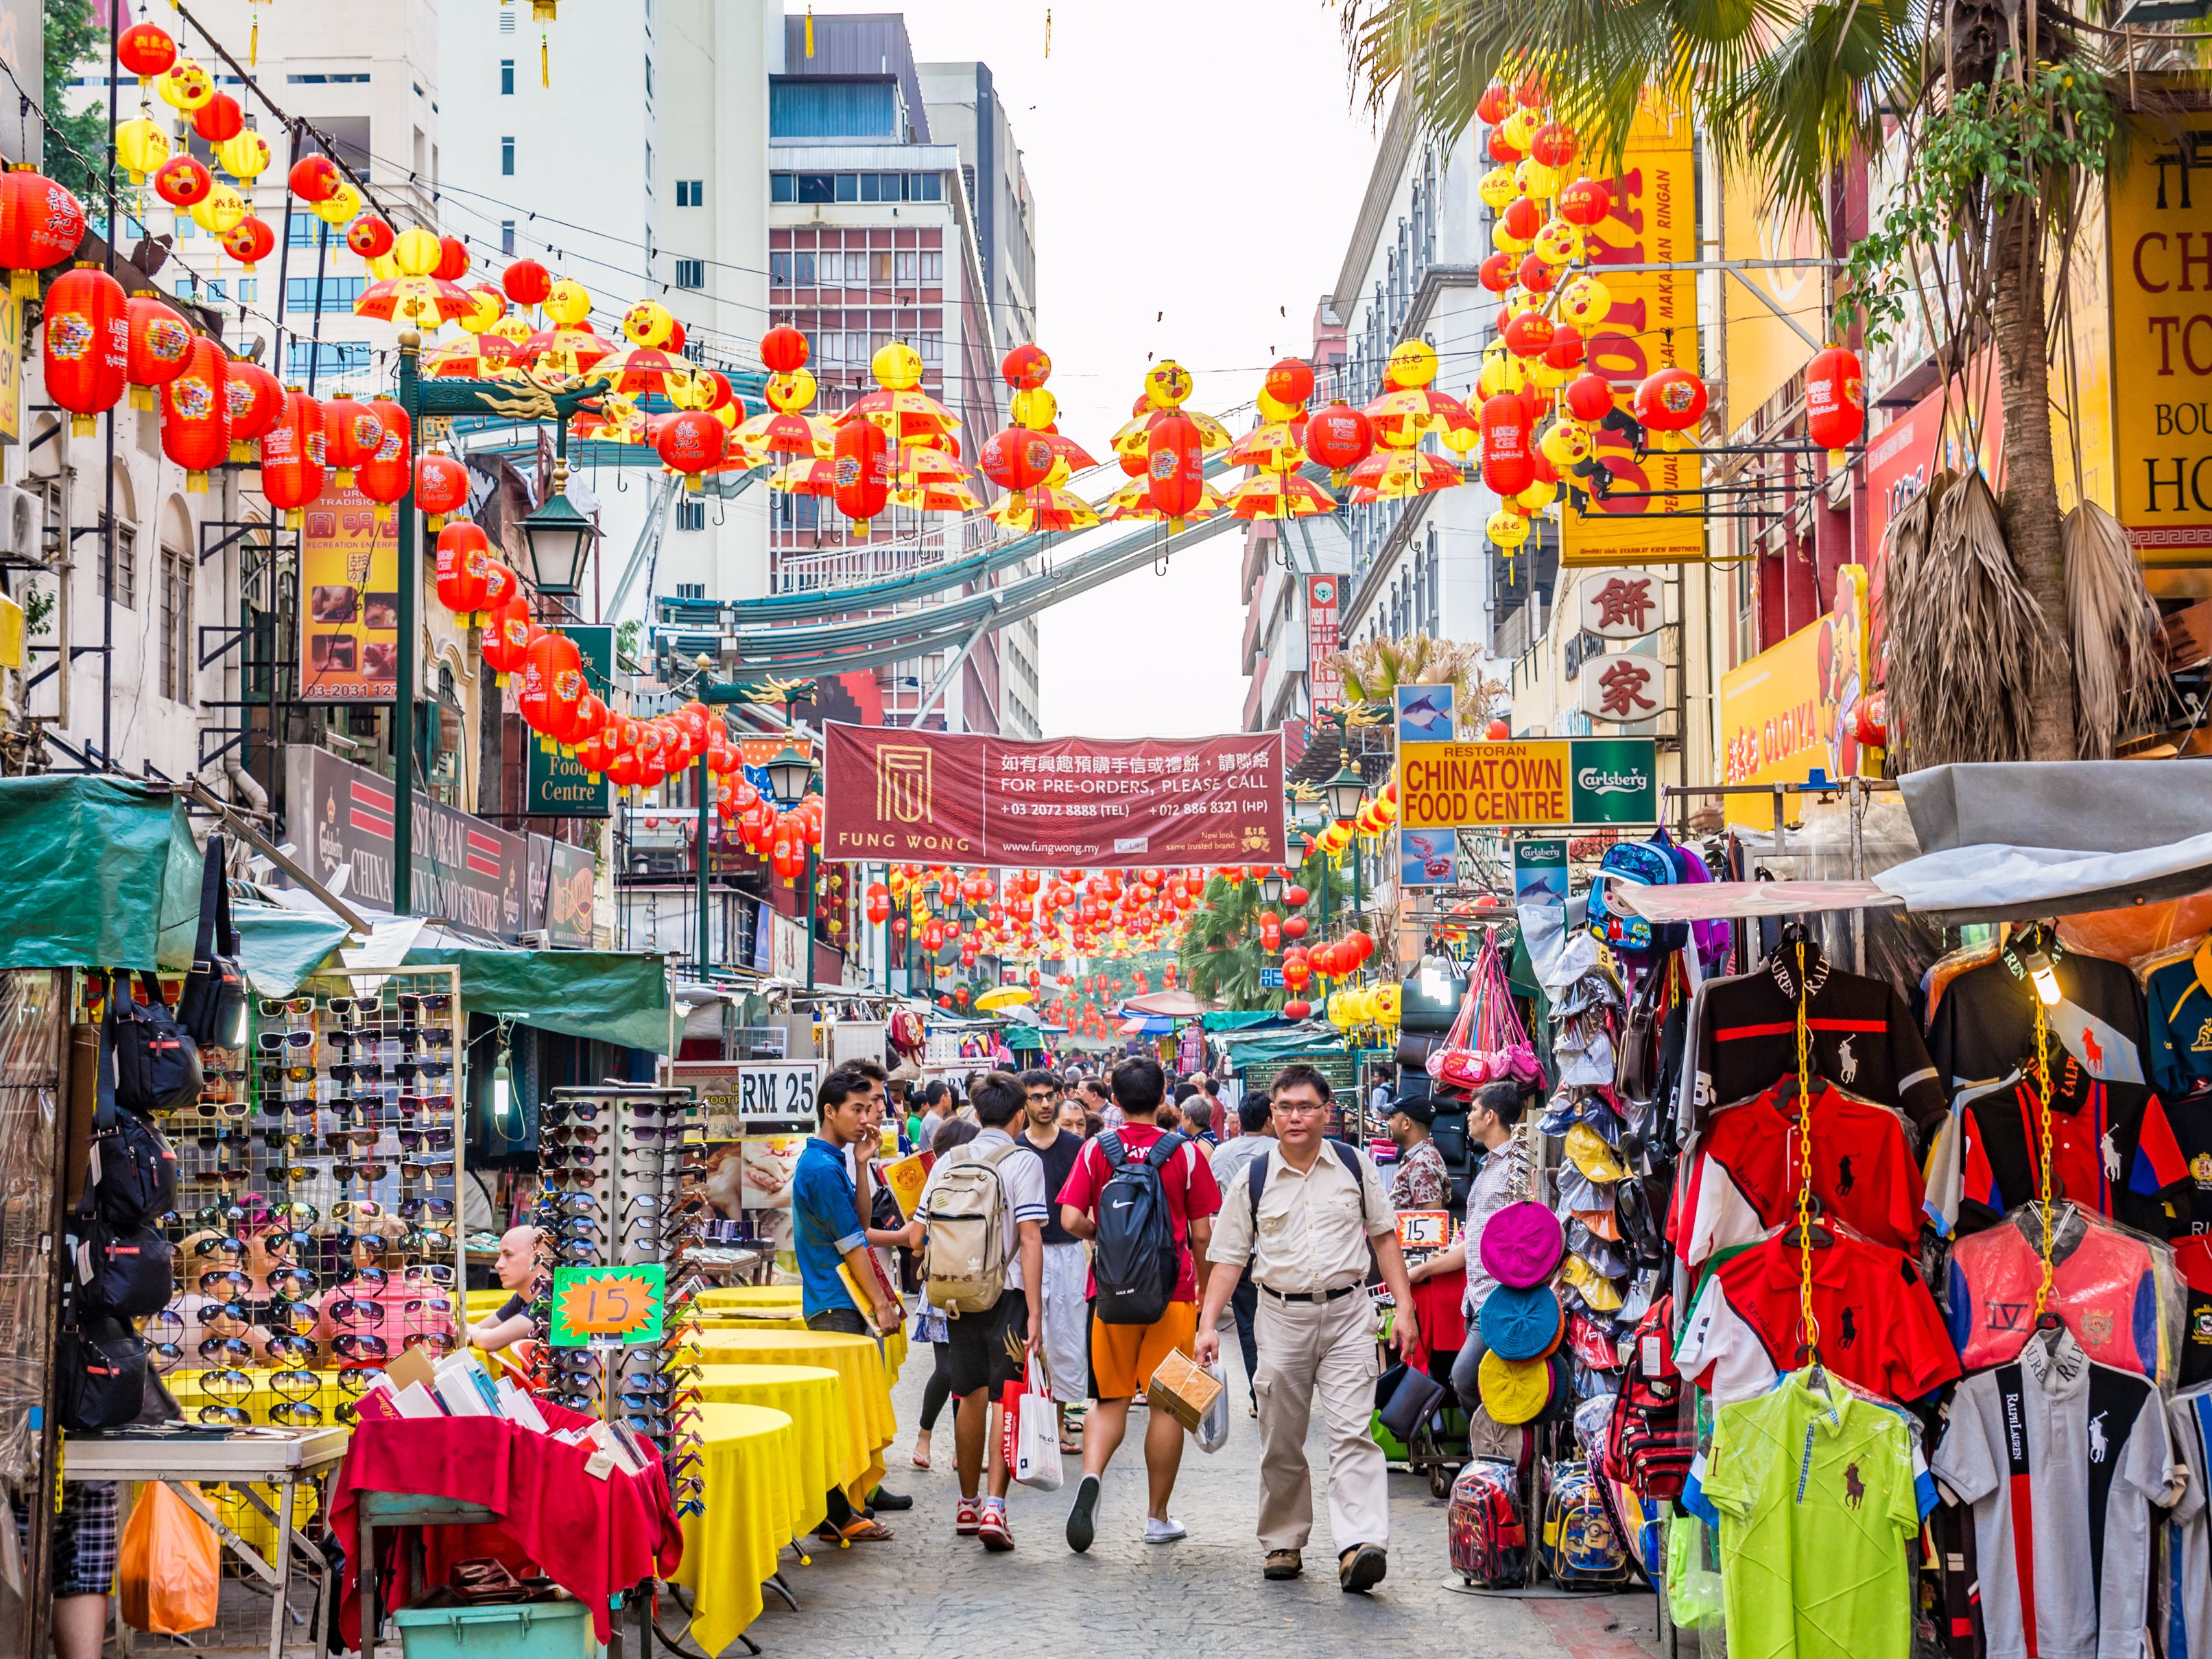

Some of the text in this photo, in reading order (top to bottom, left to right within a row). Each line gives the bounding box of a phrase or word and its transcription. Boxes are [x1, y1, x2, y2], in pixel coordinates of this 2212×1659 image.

[1656, 169, 1671, 230] RINGAN
[308, 684, 368, 697] 03-2031
[1597, 659, 1656, 716] 家
[1763, 698, 1819, 766] OLOIYA
[1443, 745, 1526, 757] RESTORAN
[1001, 774, 1268, 796] FOR PRE-ORDERS, PLEASE CALL
[1405, 758, 1562, 791] CHINATOWN
[1578, 767, 1648, 791] Carlsberg
[541, 780, 595, 801] Centre
[1001, 800, 1268, 818] +03 2072 8888 (TEL) +012 886 8321 (HP)
[1405, 791, 1565, 822] FOOD CENTRE
[839, 833, 969, 851] FUNG WONG
[1187, 842, 1213, 850] trusted
[1215, 842, 1235, 850] brand
[1201, 831, 1217, 840] New
[1002, 842, 1145, 856] www.fungwong.my Like
[1521, 846, 1560, 861] Carlsberg
[430, 873, 459, 920] FOOD
[460, 883, 499, 934] CENTRE
[704, 1095, 734, 1105] FOOT
[741, 1071, 814, 1114] RM 25
[1405, 1219, 1430, 1241] 15
[588, 1287, 629, 1322] 15
[1005, 1411, 1013, 1433] BAG
[2006, 1392, 2023, 1461] RALPH LAUREN
